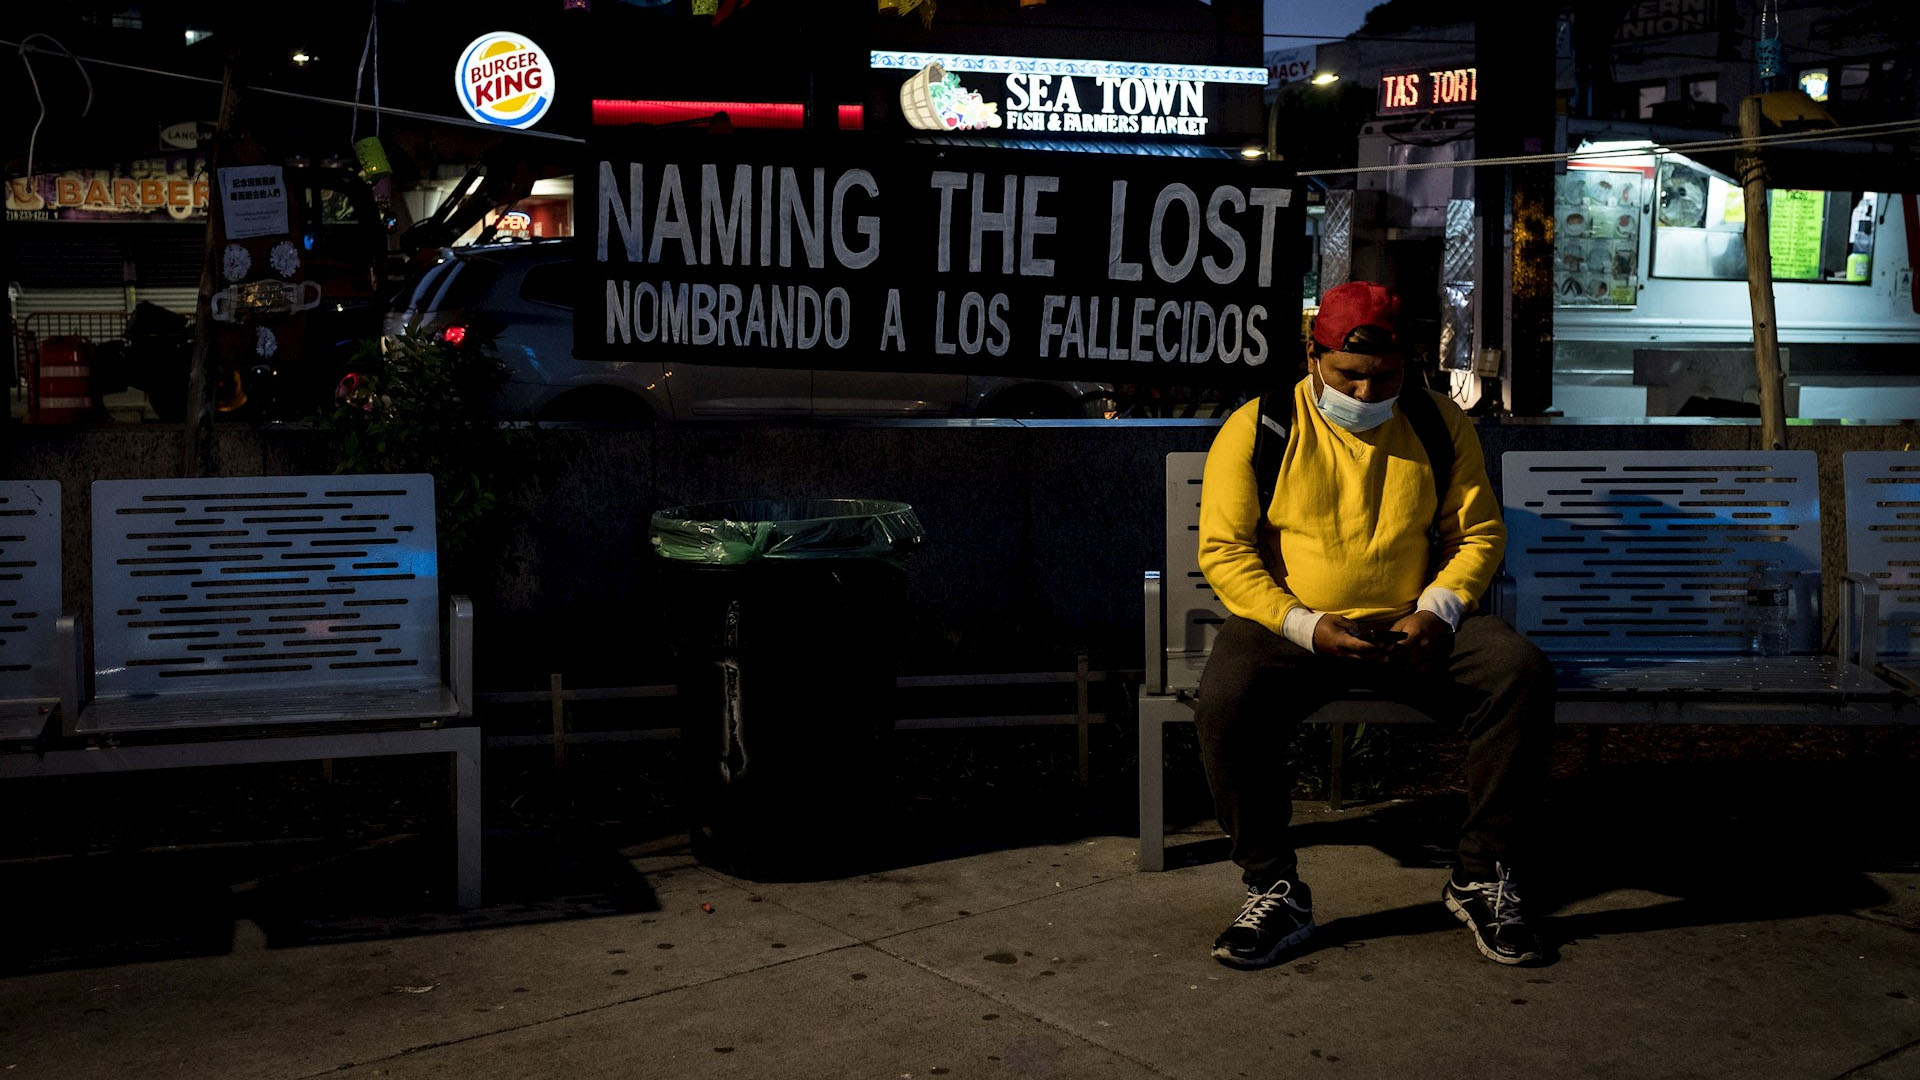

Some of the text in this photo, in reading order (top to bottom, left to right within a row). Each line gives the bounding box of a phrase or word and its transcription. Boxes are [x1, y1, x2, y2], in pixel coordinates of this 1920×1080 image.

[471, 52, 538, 84] BURGER
[476, 68, 542, 107] KING
[1005, 73, 1206, 117] SEA TOWN
[1383, 74, 1419, 107] TAS
[1006, 111, 1208, 136] FISH & FARMERS MARKET
[598, 161, 1291, 288] NAMING THE LOST
[607, 280, 1268, 367] NOMBRANDO A LOS FALLECIDOS
